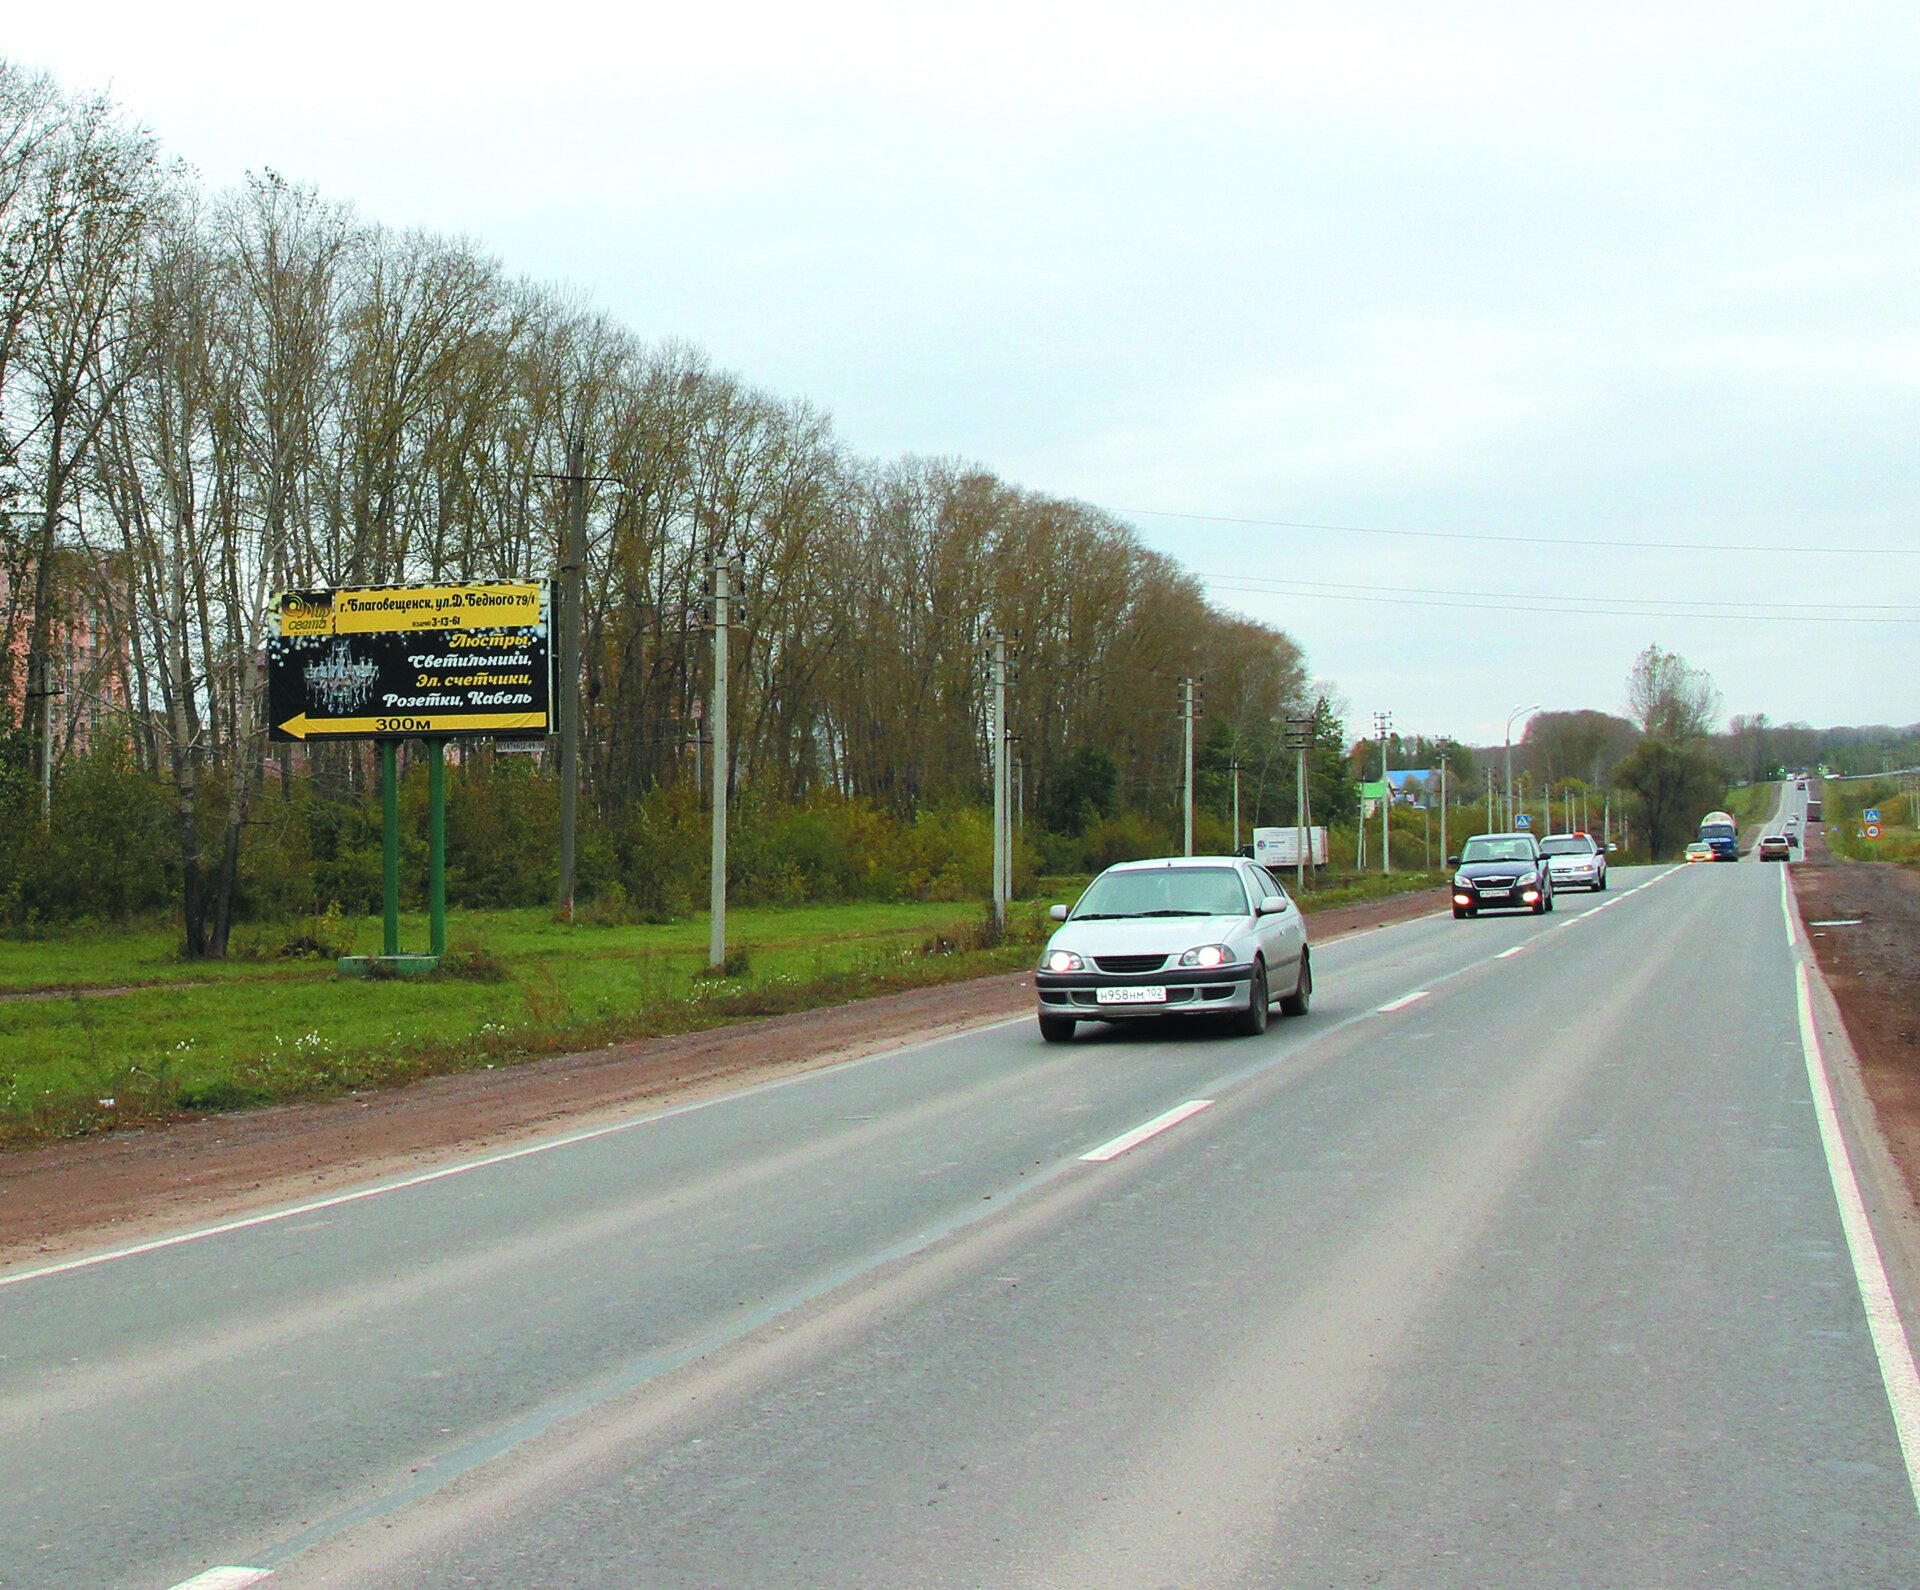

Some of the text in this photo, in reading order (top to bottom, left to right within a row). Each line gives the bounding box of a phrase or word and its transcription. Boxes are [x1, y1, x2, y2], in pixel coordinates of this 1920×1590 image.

[288, 619, 327, 630] света
[432, 616, 460, 627] 3-13-61
[449, 633, 532, 649] Люстры,
[407, 654, 532, 668] Светильники,
[416, 672, 533, 687] Эл. счетчики,
[382, 691, 532, 707] Розетки, Кабель
[1101, 988, 1162, 1000] Н958НМ 102
